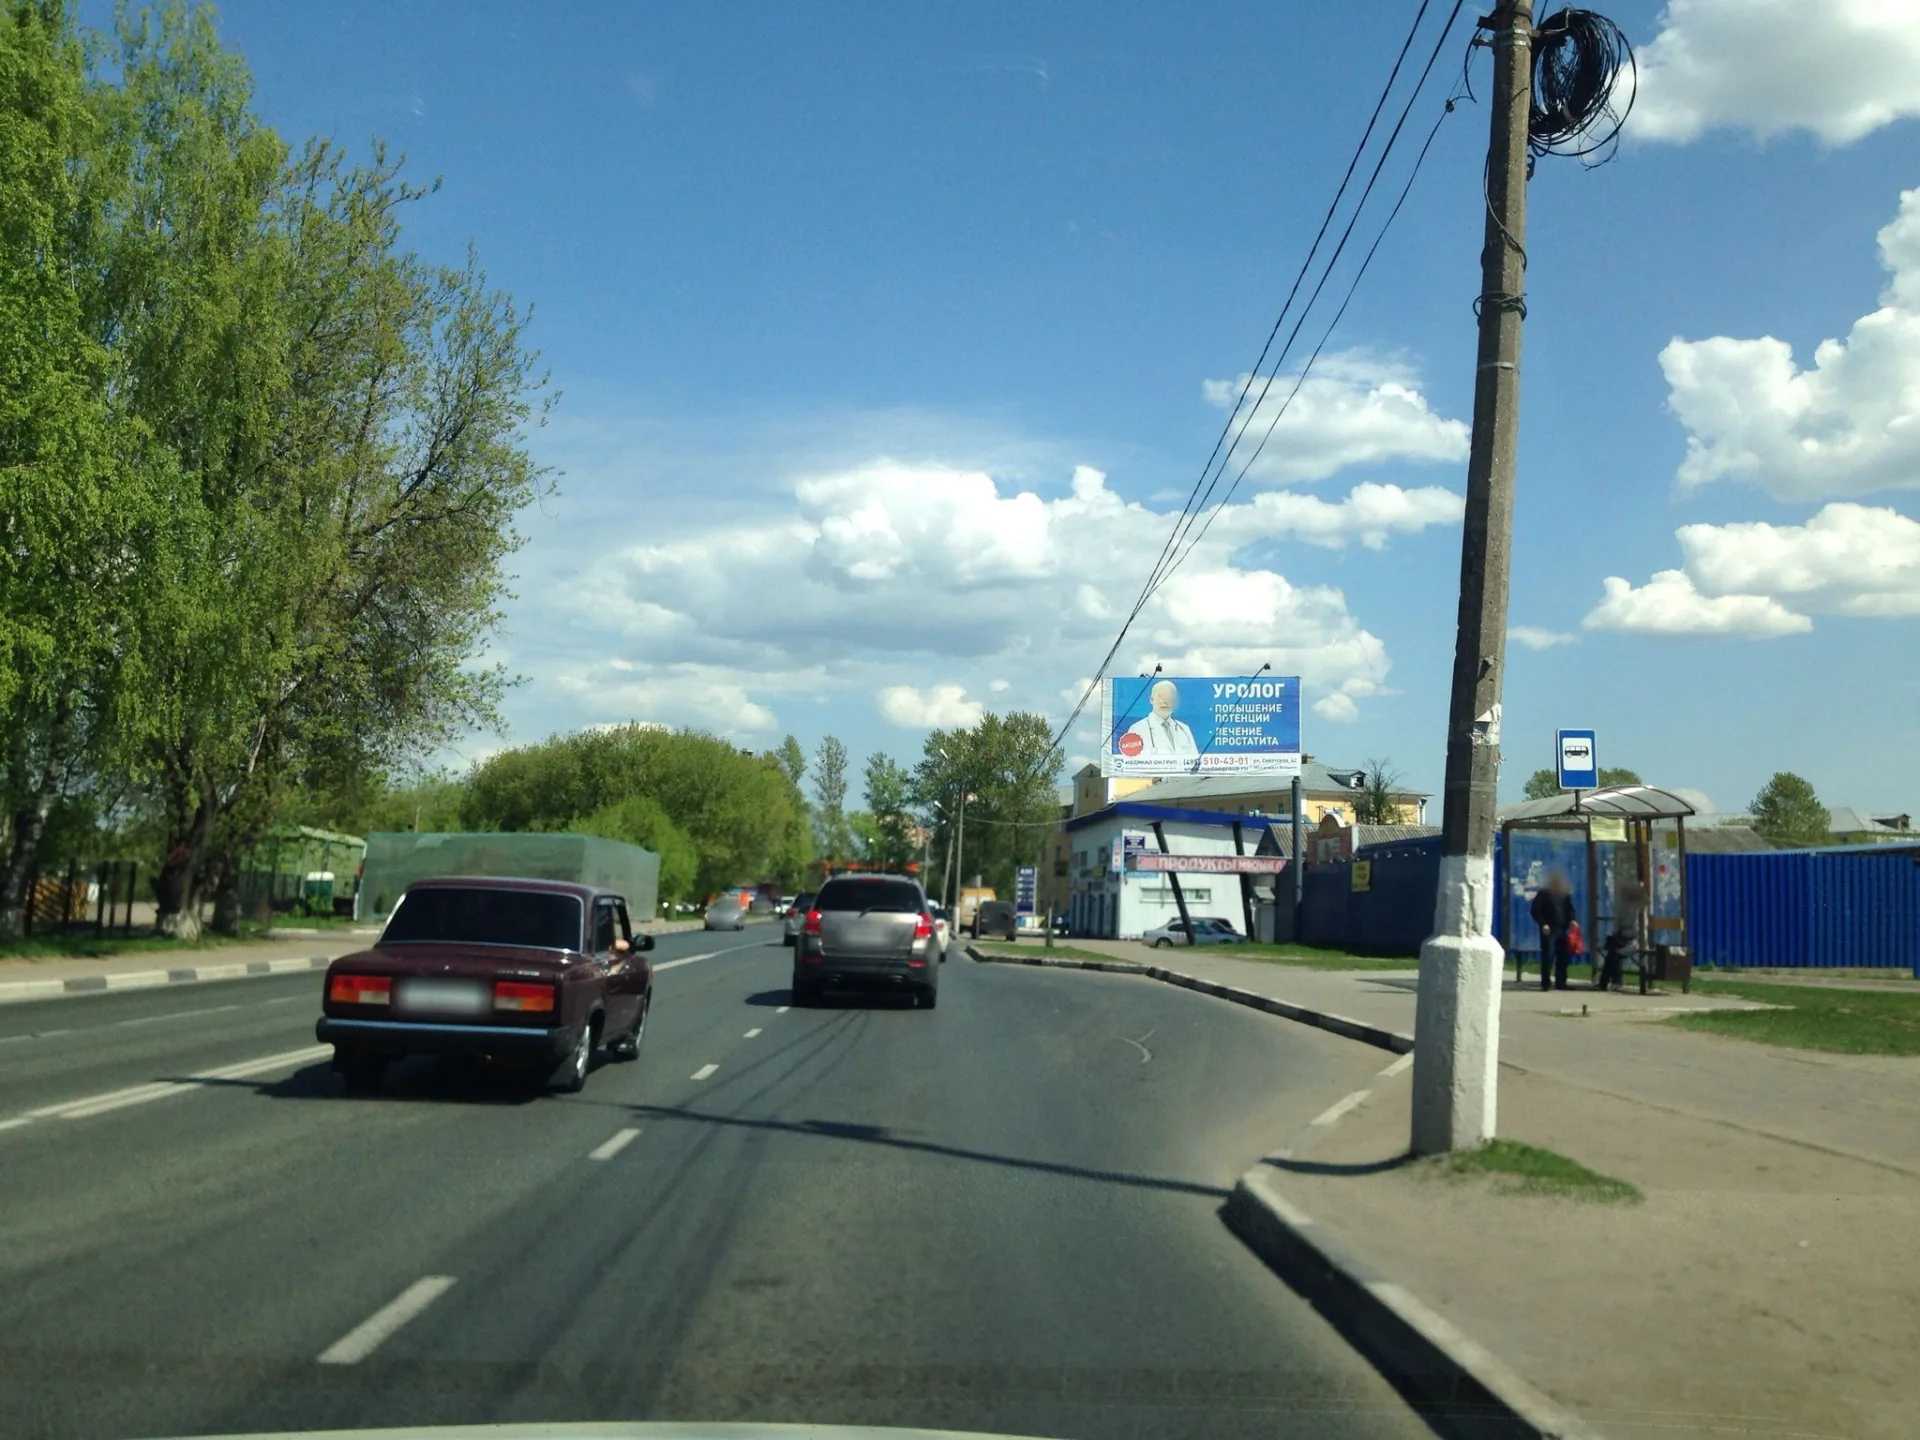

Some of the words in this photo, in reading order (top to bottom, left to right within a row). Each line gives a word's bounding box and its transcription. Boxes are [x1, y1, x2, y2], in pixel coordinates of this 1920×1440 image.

[1212, 683, 1285, 699] УРОЛОГ
[1215, 704, 1282, 713] ПОВЫШЕНИЕ
[1215, 714, 1270, 723] ПОТЕНЦИИ
[1216, 727, 1262, 736] ЛЕЧЕНИЕ
[1215, 737, 1279, 746] ПРОСТАТИТА
[1203, 756, 1249, 765] 510-43-01
[1157, 857, 1237, 871] ПРОДУКТЫ
